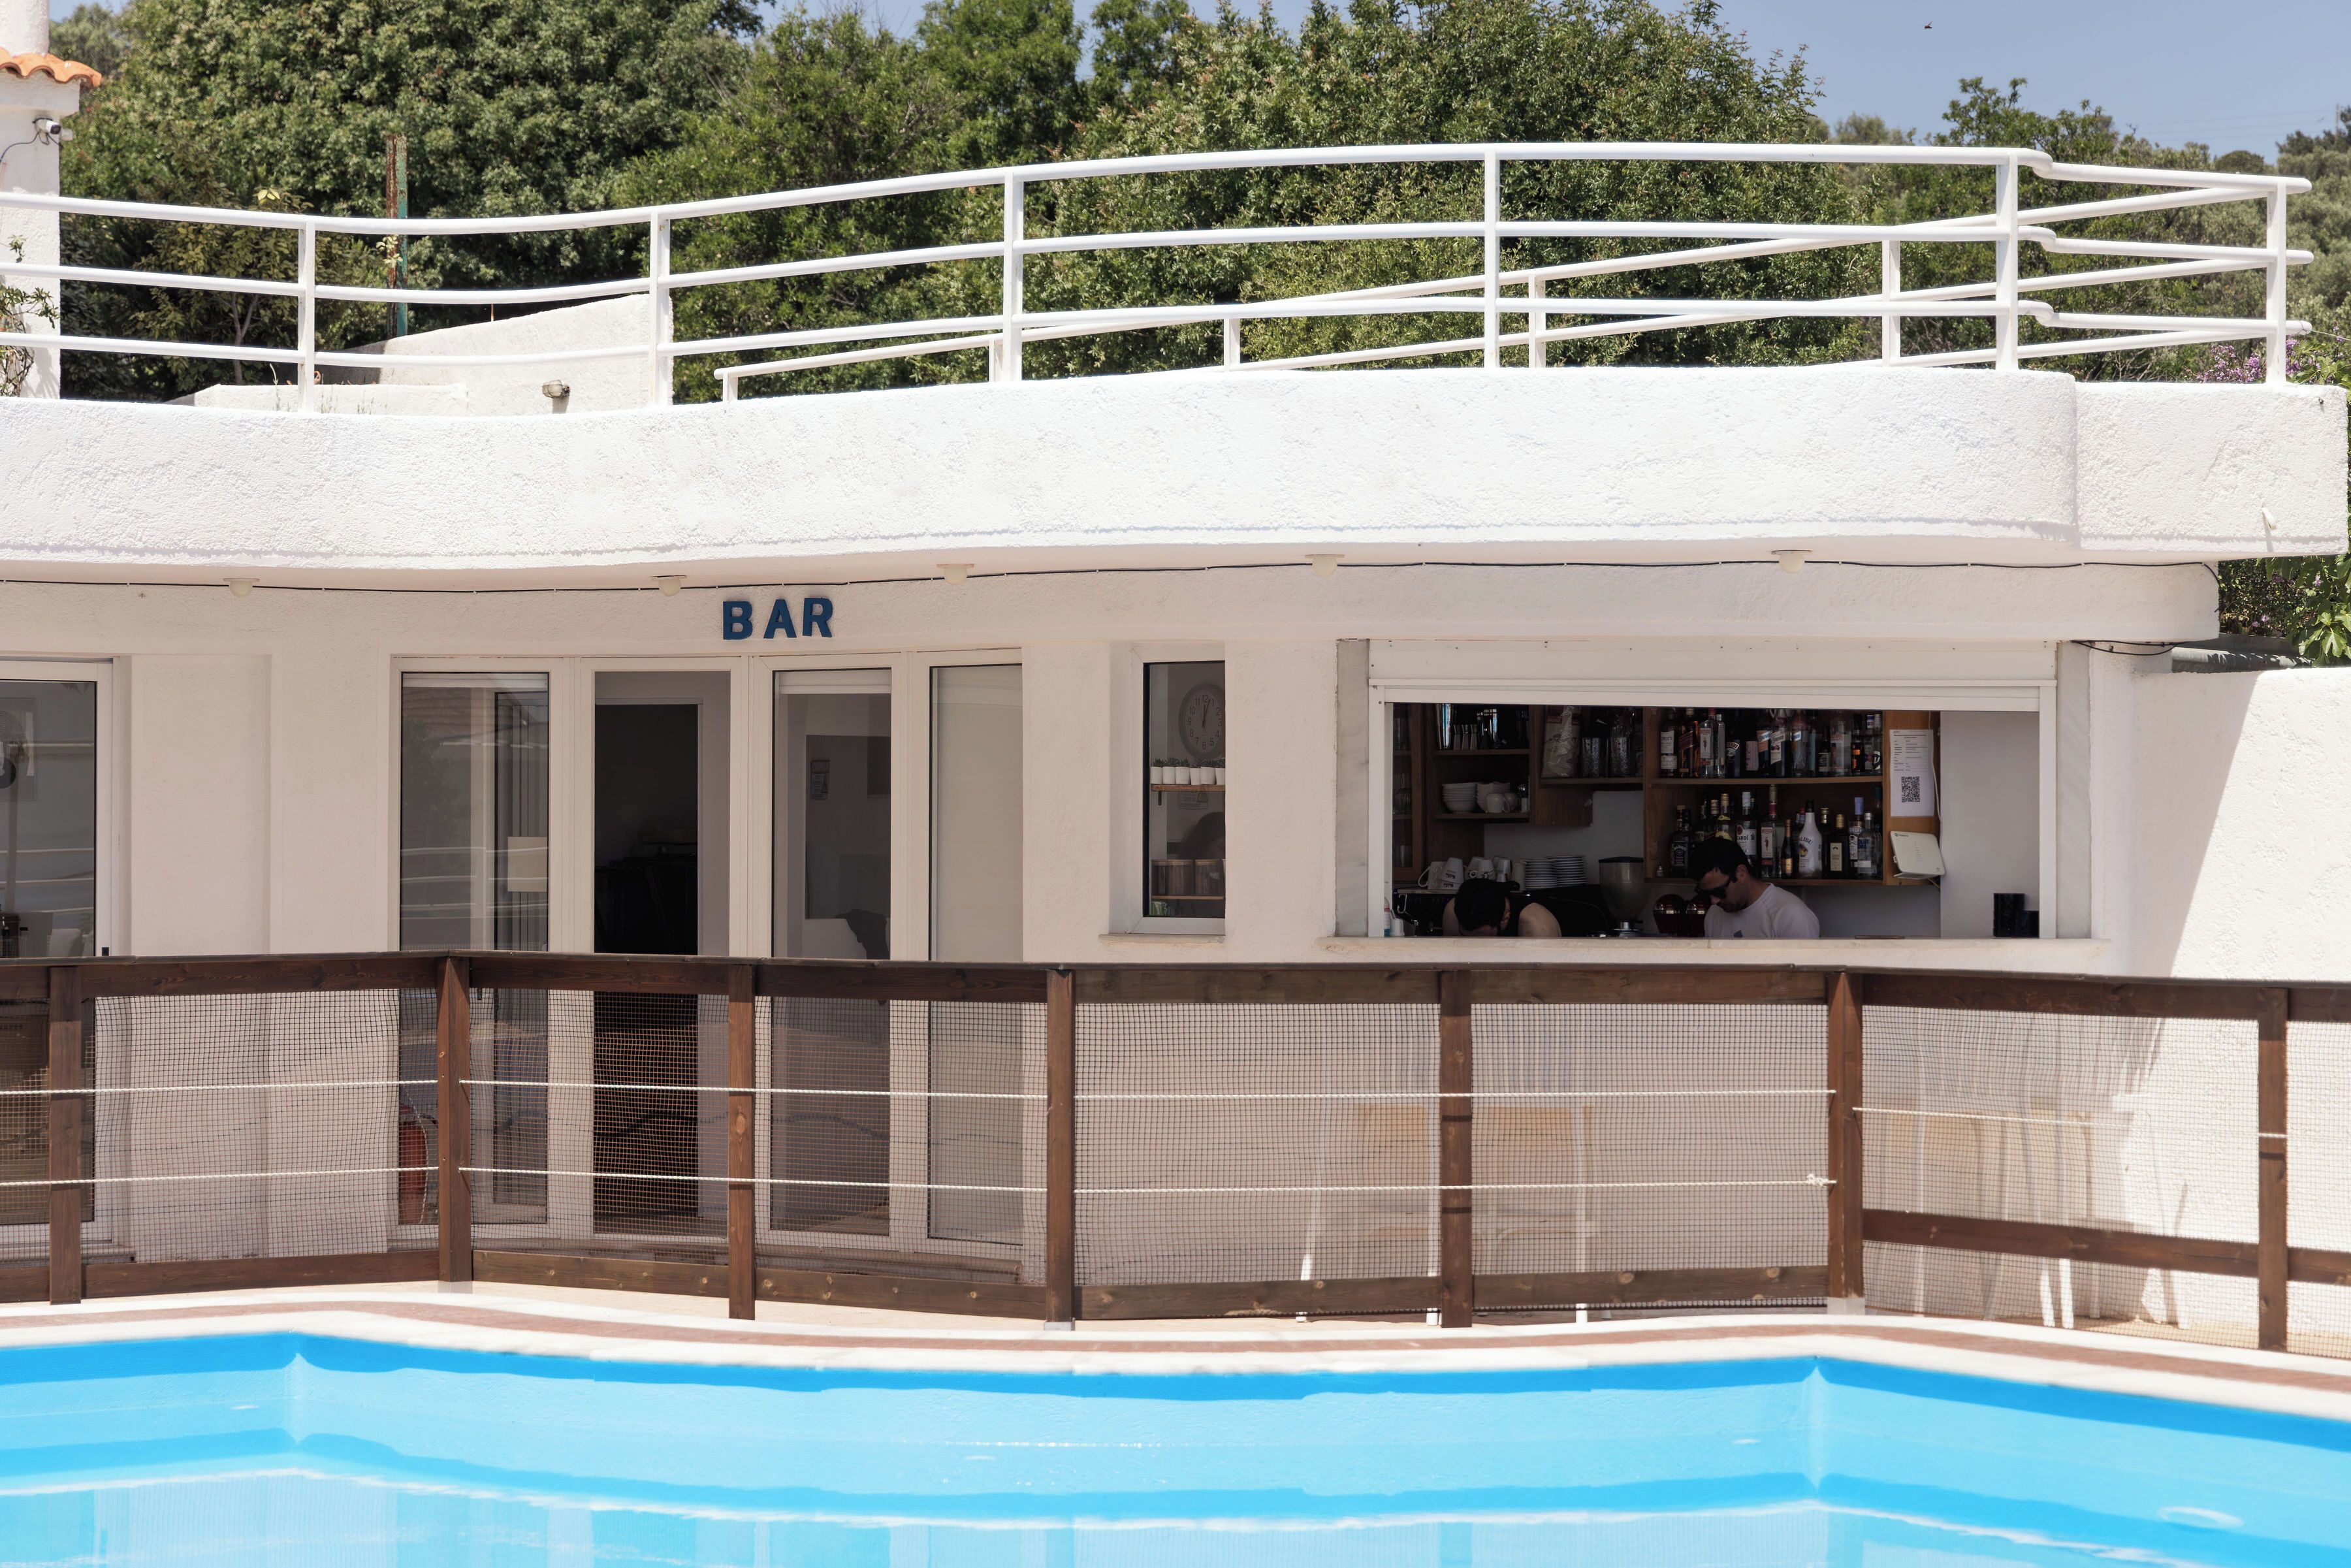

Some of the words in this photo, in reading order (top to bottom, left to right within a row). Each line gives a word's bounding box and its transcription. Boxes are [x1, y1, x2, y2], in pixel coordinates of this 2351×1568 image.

[722, 597, 833, 641] BAR
[1202, 694, 1208, 703] 12
[1190, 706, 1196, 715] 10
[1216, 707, 1221, 716] 2
[1187, 717, 1192, 726] 9
[1218, 718, 1223, 727] 3
[1190, 729, 1194, 737] 8
[1194, 737, 1199, 746] 7
[1202, 741, 1206, 750] 6
[1209, 737, 1215, 746] 5
[1799, 837, 1813, 846] ALIBU
